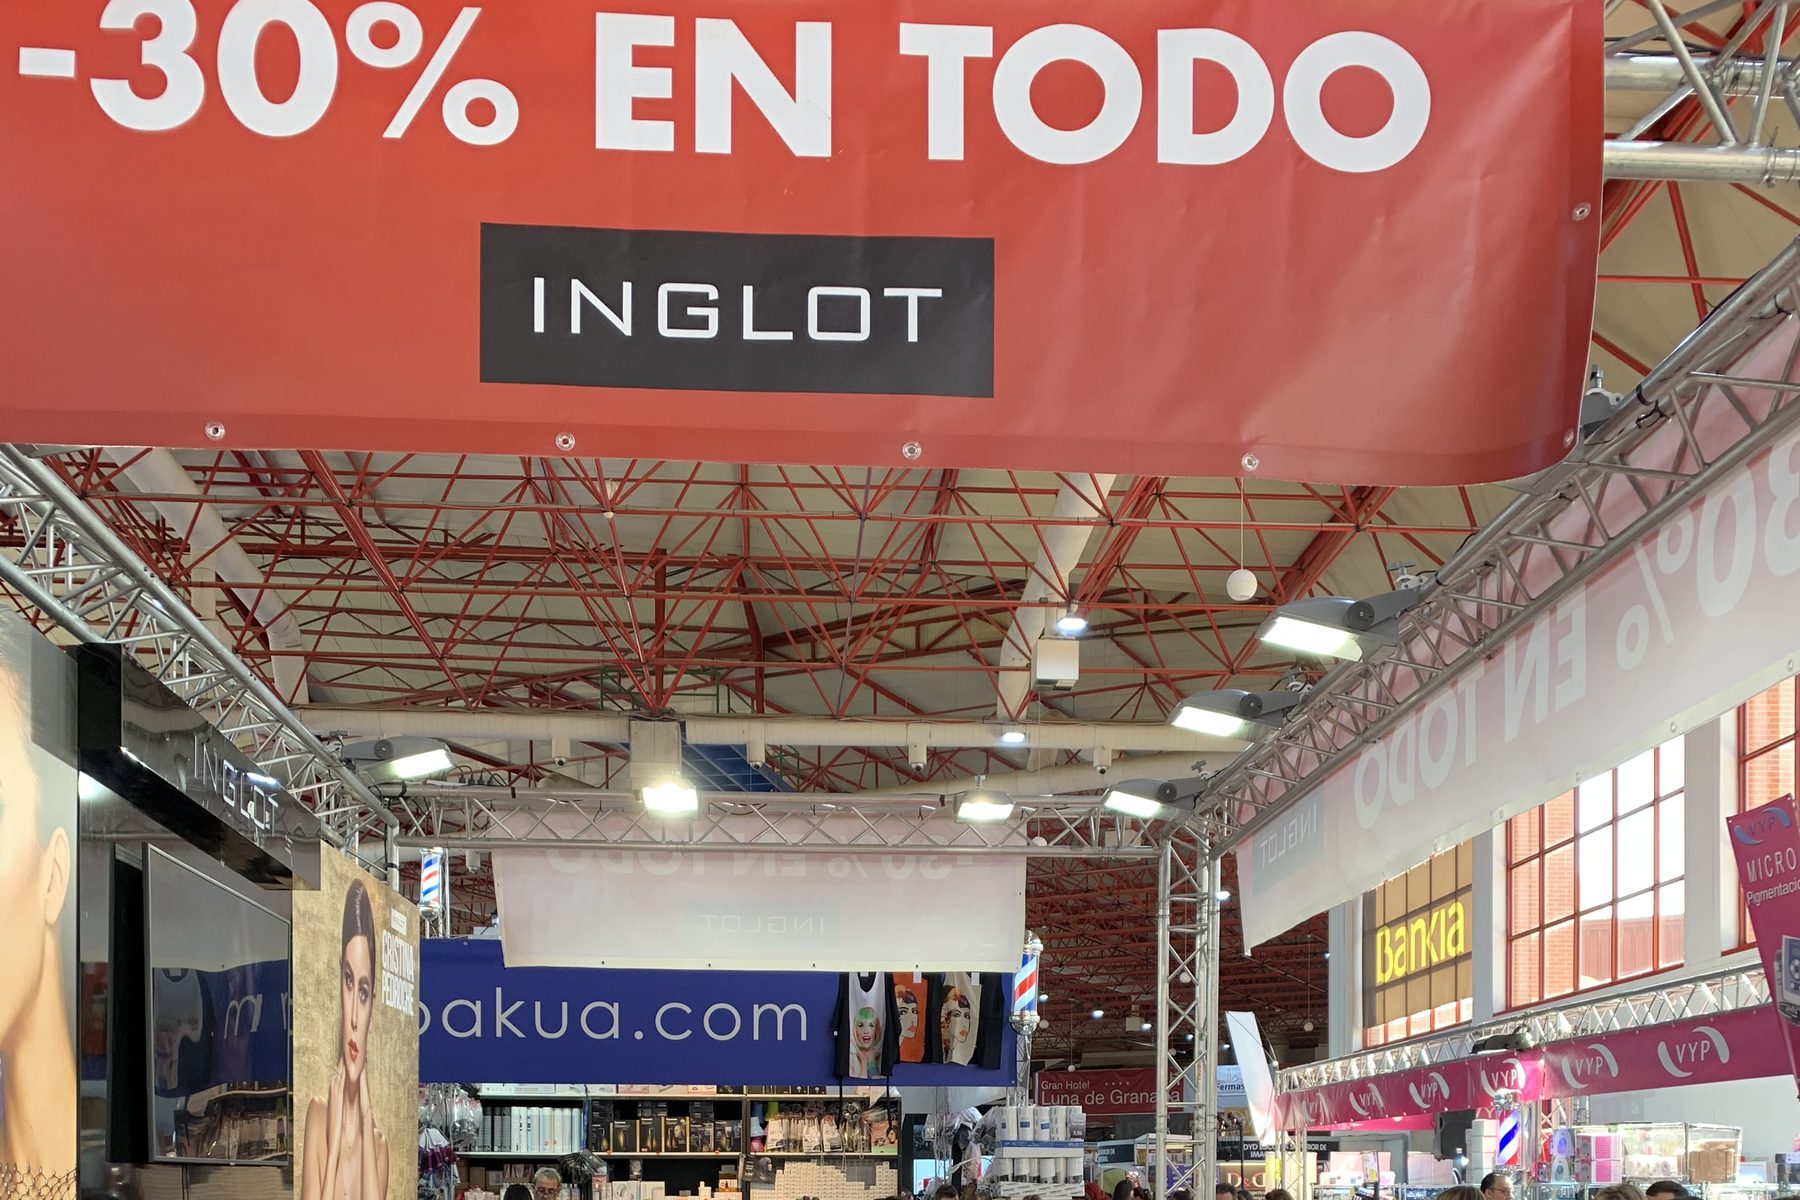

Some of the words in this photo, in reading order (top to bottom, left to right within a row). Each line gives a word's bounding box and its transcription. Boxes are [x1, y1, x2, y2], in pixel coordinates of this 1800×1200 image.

[18, 0, 520, 147] -30%
[595, 11, 833, 158] EN
[899, 22, 1432, 173] TODO
[532, 276, 943, 344] INGLOT
[193, 734, 279, 837] INGLOT
[1746, 847, 1797, 884] MICRO
[1375, 900, 1466, 985] Bankia
[1675, 1039, 1711, 1065] VYP
[1575, 1055, 1605, 1077] VYP
[1041, 1080, 1064, 1091] Gran
[1065, 1080, 1090, 1090] Hotel
[1420, 1081, 1439, 1099] VYP
[1491, 1070, 1518, 1088] VYP
[1041, 1091, 1083, 1106] Luna
[1084, 1090, 1105, 1106] de
[1109, 1089, 1181, 1105] Granaa
[1319, 1143, 1328, 1151] DE
